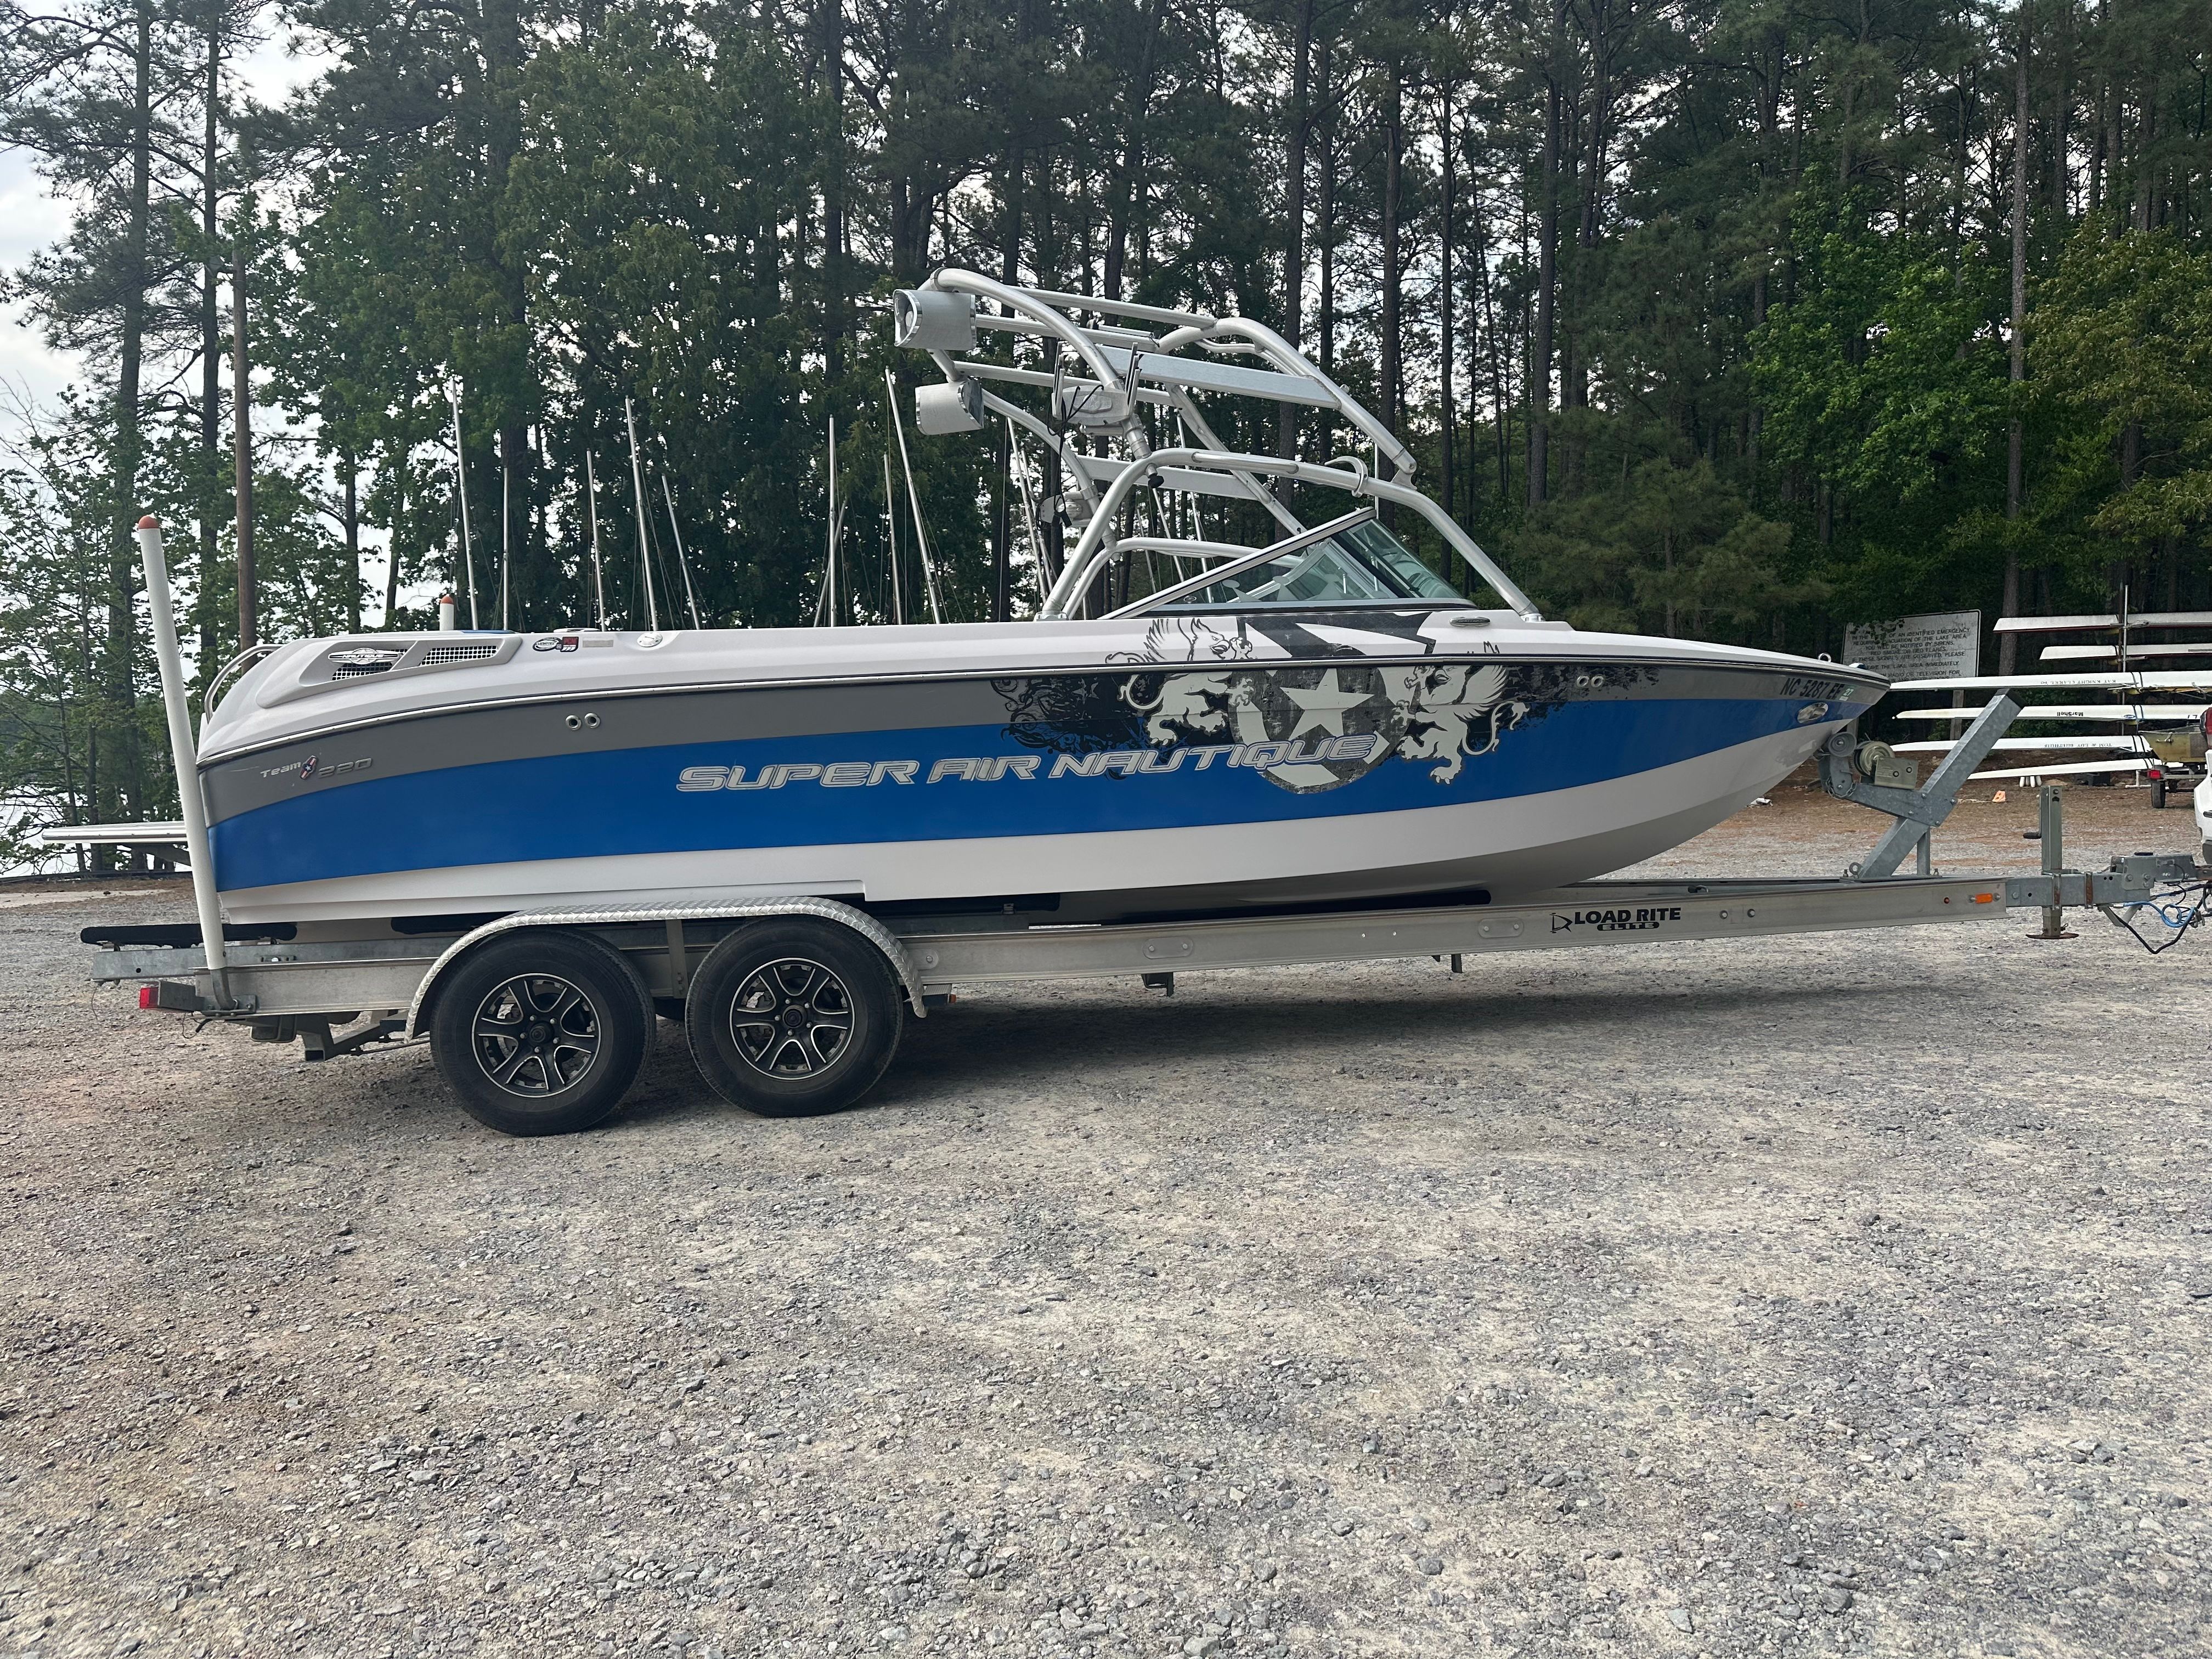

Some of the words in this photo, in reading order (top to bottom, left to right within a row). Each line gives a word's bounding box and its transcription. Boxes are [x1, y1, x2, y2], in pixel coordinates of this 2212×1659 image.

[1780, 678, 1801, 696] NC
[1843, 688, 1854, 696] 27
[318, 758, 373, 779] 220
[676, 760, 920, 792] SUPER
[926, 755, 1042, 785] AIR
[1048, 733, 1376, 779] NAUTIQUE
[1575, 909, 1631, 924] LOAD
[1637, 907, 1681, 922] RITE
[1602, 922, 1655, 930] ELITE
